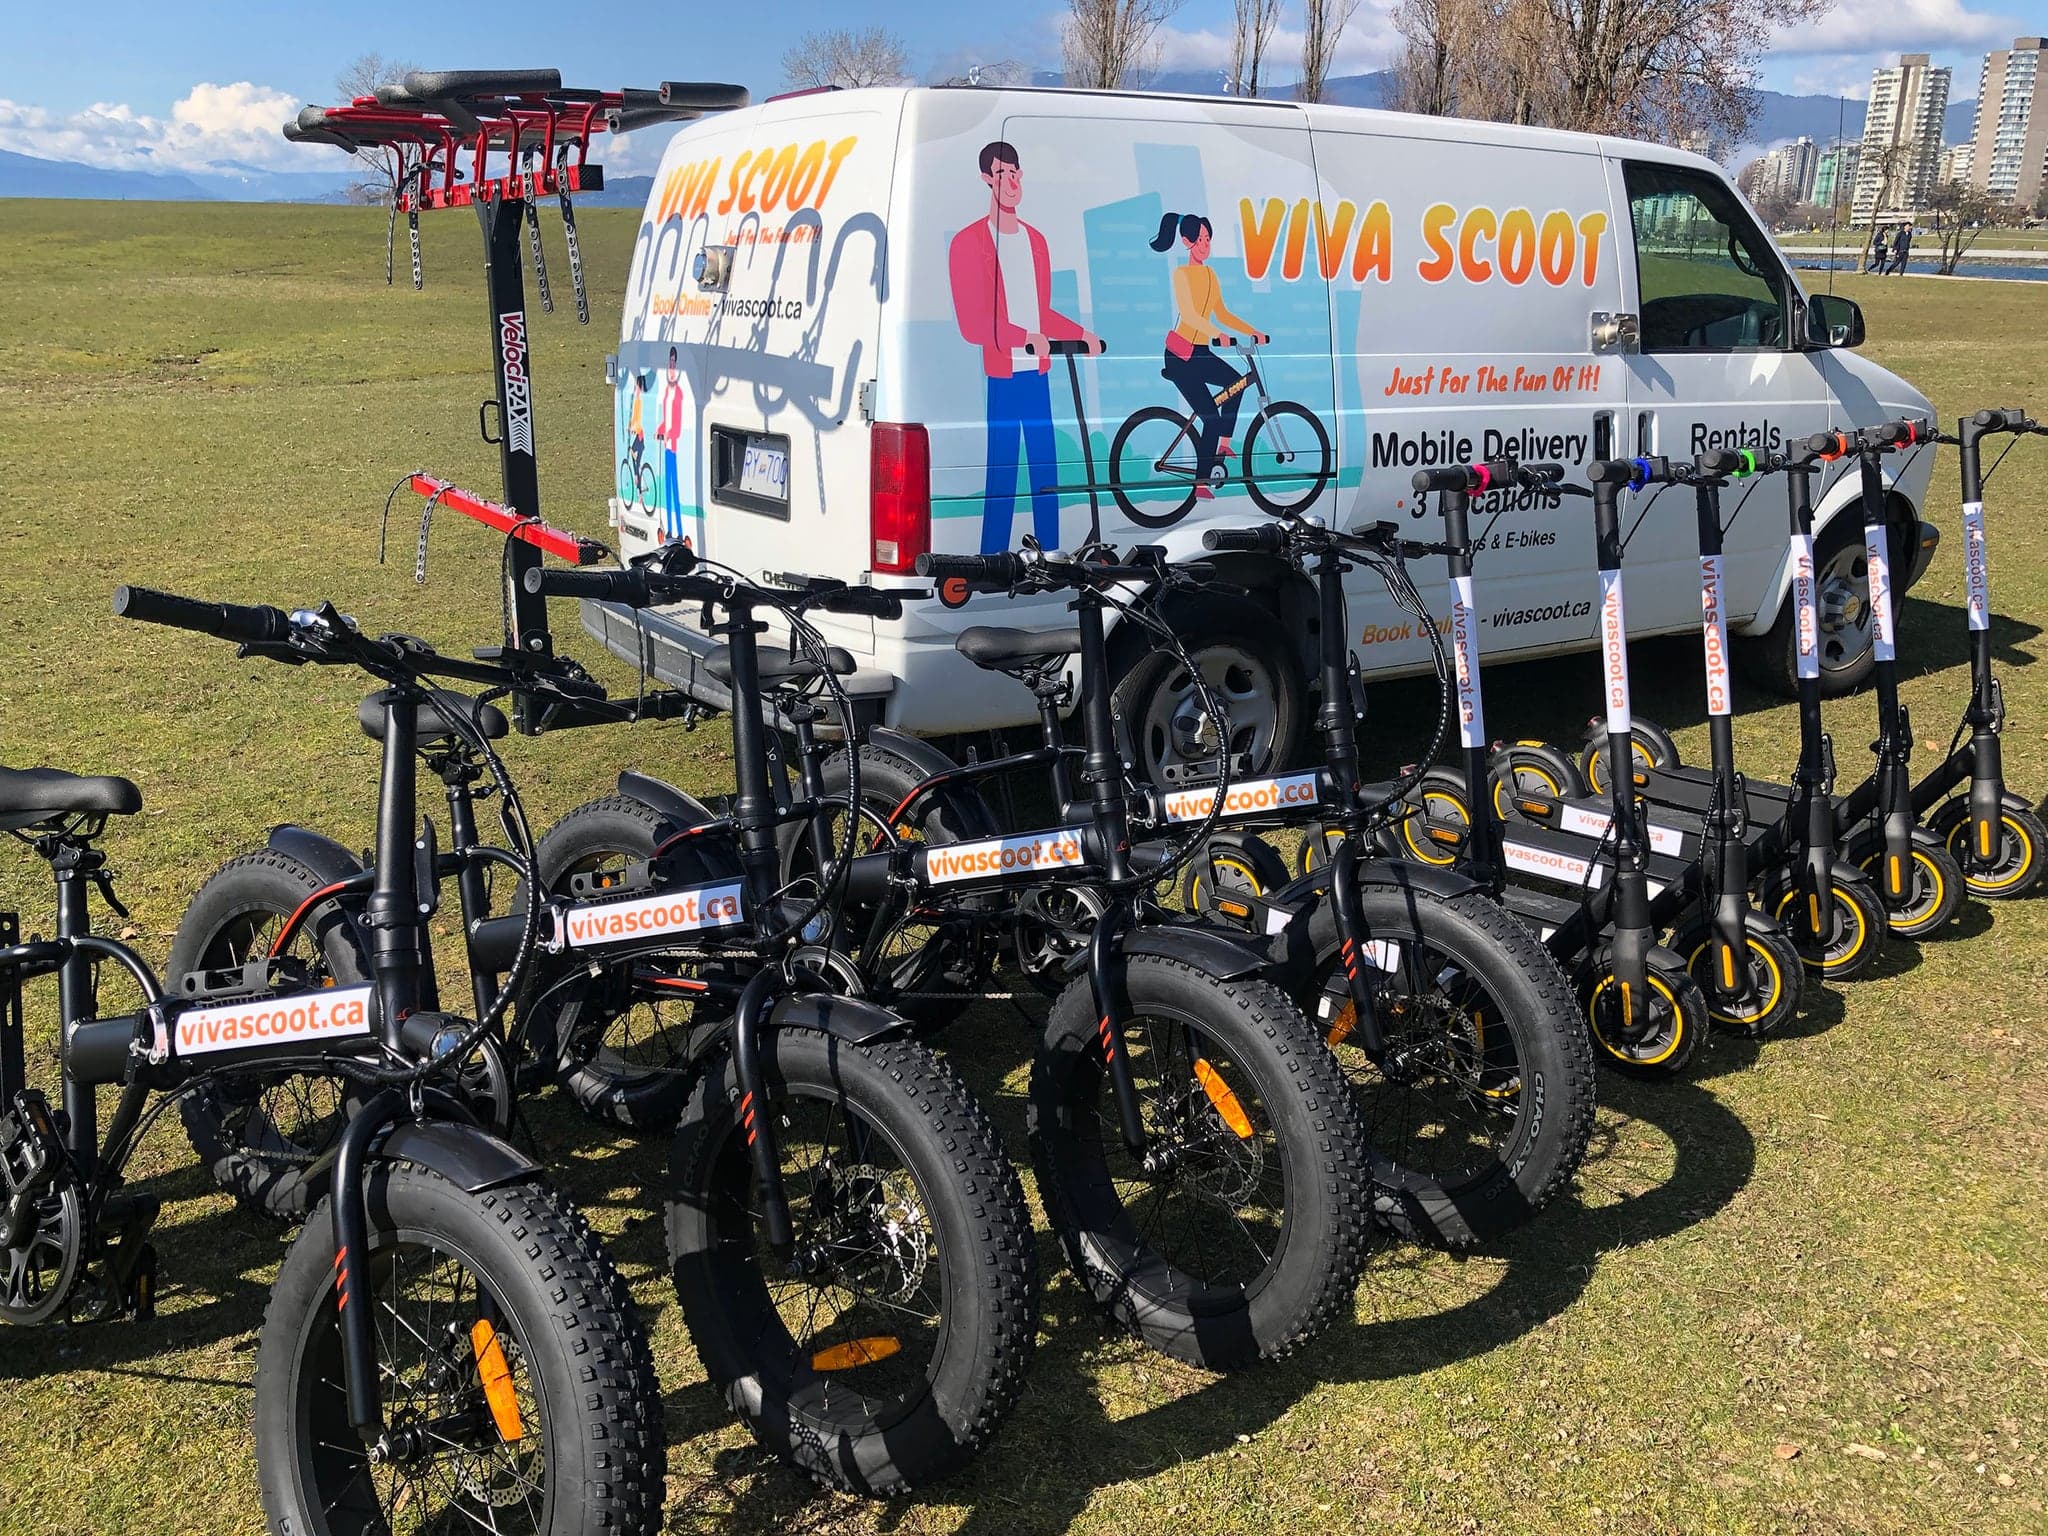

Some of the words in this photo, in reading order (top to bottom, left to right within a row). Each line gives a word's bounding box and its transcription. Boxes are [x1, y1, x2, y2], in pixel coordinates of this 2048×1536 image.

[656, 156, 722, 225] VIVA
[717, 136, 858, 216] SCOOT
[1239, 197, 1393, 283] VIVA
[1417, 202, 1608, 289] SCOOT
[652, 293, 675, 316] Book
[677, 292, 711, 317] Online
[721, 294, 803, 320] vivascoot.ca
[500, 311, 530, 424] VelociRAX
[1385, 366, 1435, 396] Just
[1440, 366, 1470, 394] For
[1477, 366, 1510, 392] The
[1514, 366, 1547, 392] Fun
[1552, 365, 1574, 391] Of
[1578, 365, 1600, 392] It!
[1372, 431, 1473, 468] Mobile
[1484, 427, 1588, 466] Delivery
[1691, 419, 1781, 455] Rentals
[1411, 489, 1427, 518] 3
[1491, 535, 1501, 549] &
[1505, 531, 1556, 549] E-bikes
[1967, 519, 1984, 611] vivascoot.ca
[1867, 544, 1884, 641] vivascoot.ca
[1362, 621, 1410, 645] Book
[1493, 601, 1591, 628] vivascoot.ca
[1701, 558, 1725, 713] vivascoot.ca
[1453, 600, 1475, 724] vivascoot.ca
[1604, 592, 1625, 709] vivascoot.ca
[1168, 783, 1314, 819] vivacoot.ca
[928, 836, 1080, 877] vivascoot.ca
[1503, 846, 1585, 874] ivascoot.ca
[570, 891, 739, 940] vivascoot.ca
[181, 998, 365, 1045] vivascoot.ca
